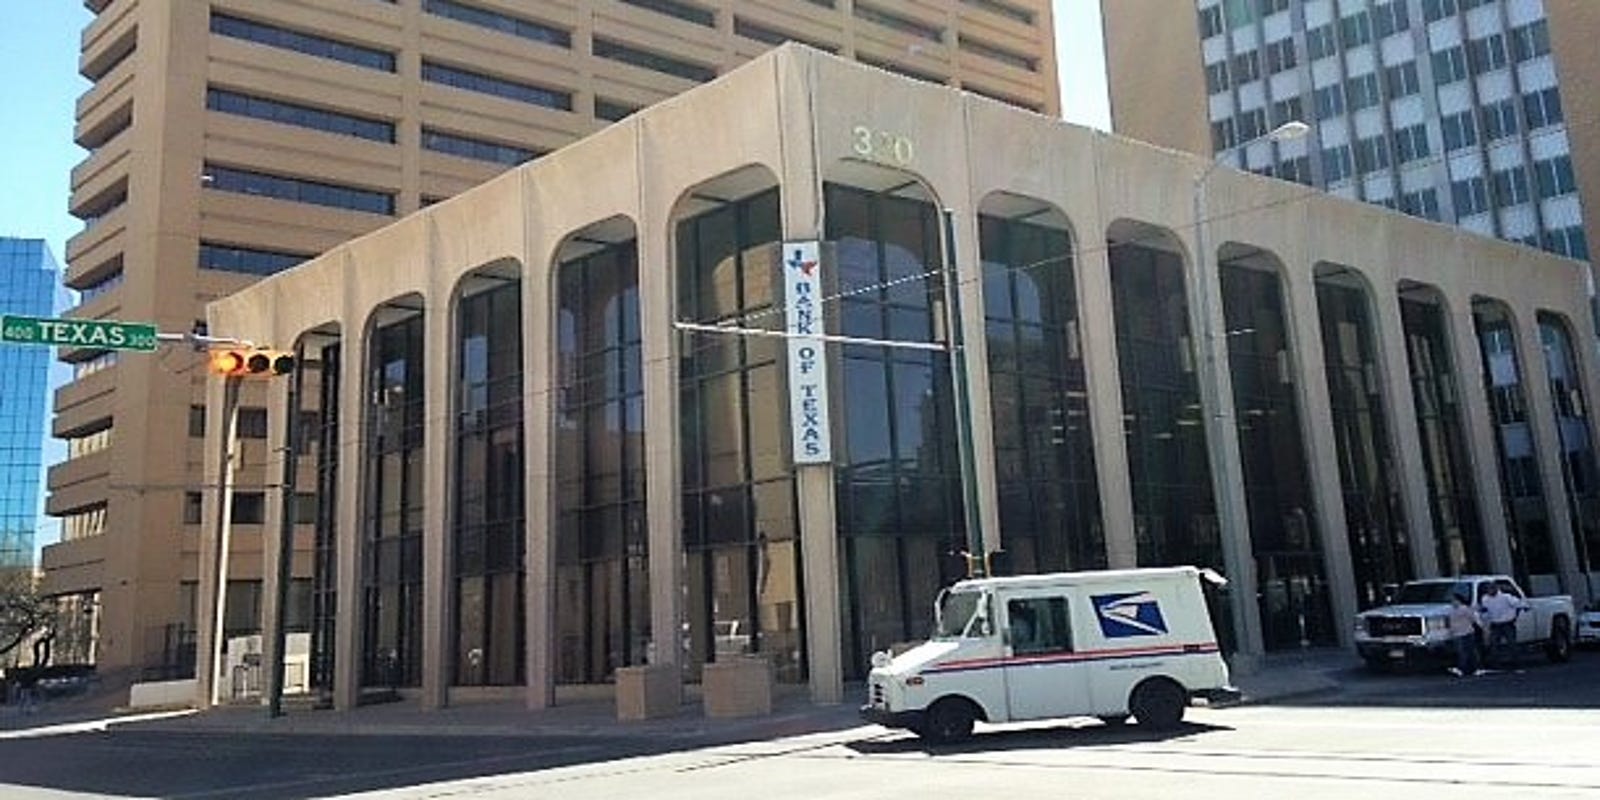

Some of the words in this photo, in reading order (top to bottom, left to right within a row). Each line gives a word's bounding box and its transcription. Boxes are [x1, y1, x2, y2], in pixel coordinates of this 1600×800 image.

[795, 281, 812, 335] BANK
[5, 326, 33, 339] 400
[37, 321, 125, 345] TEXAS
[798, 346, 815, 374] OF
[800, 384, 820, 456] TEXAS
